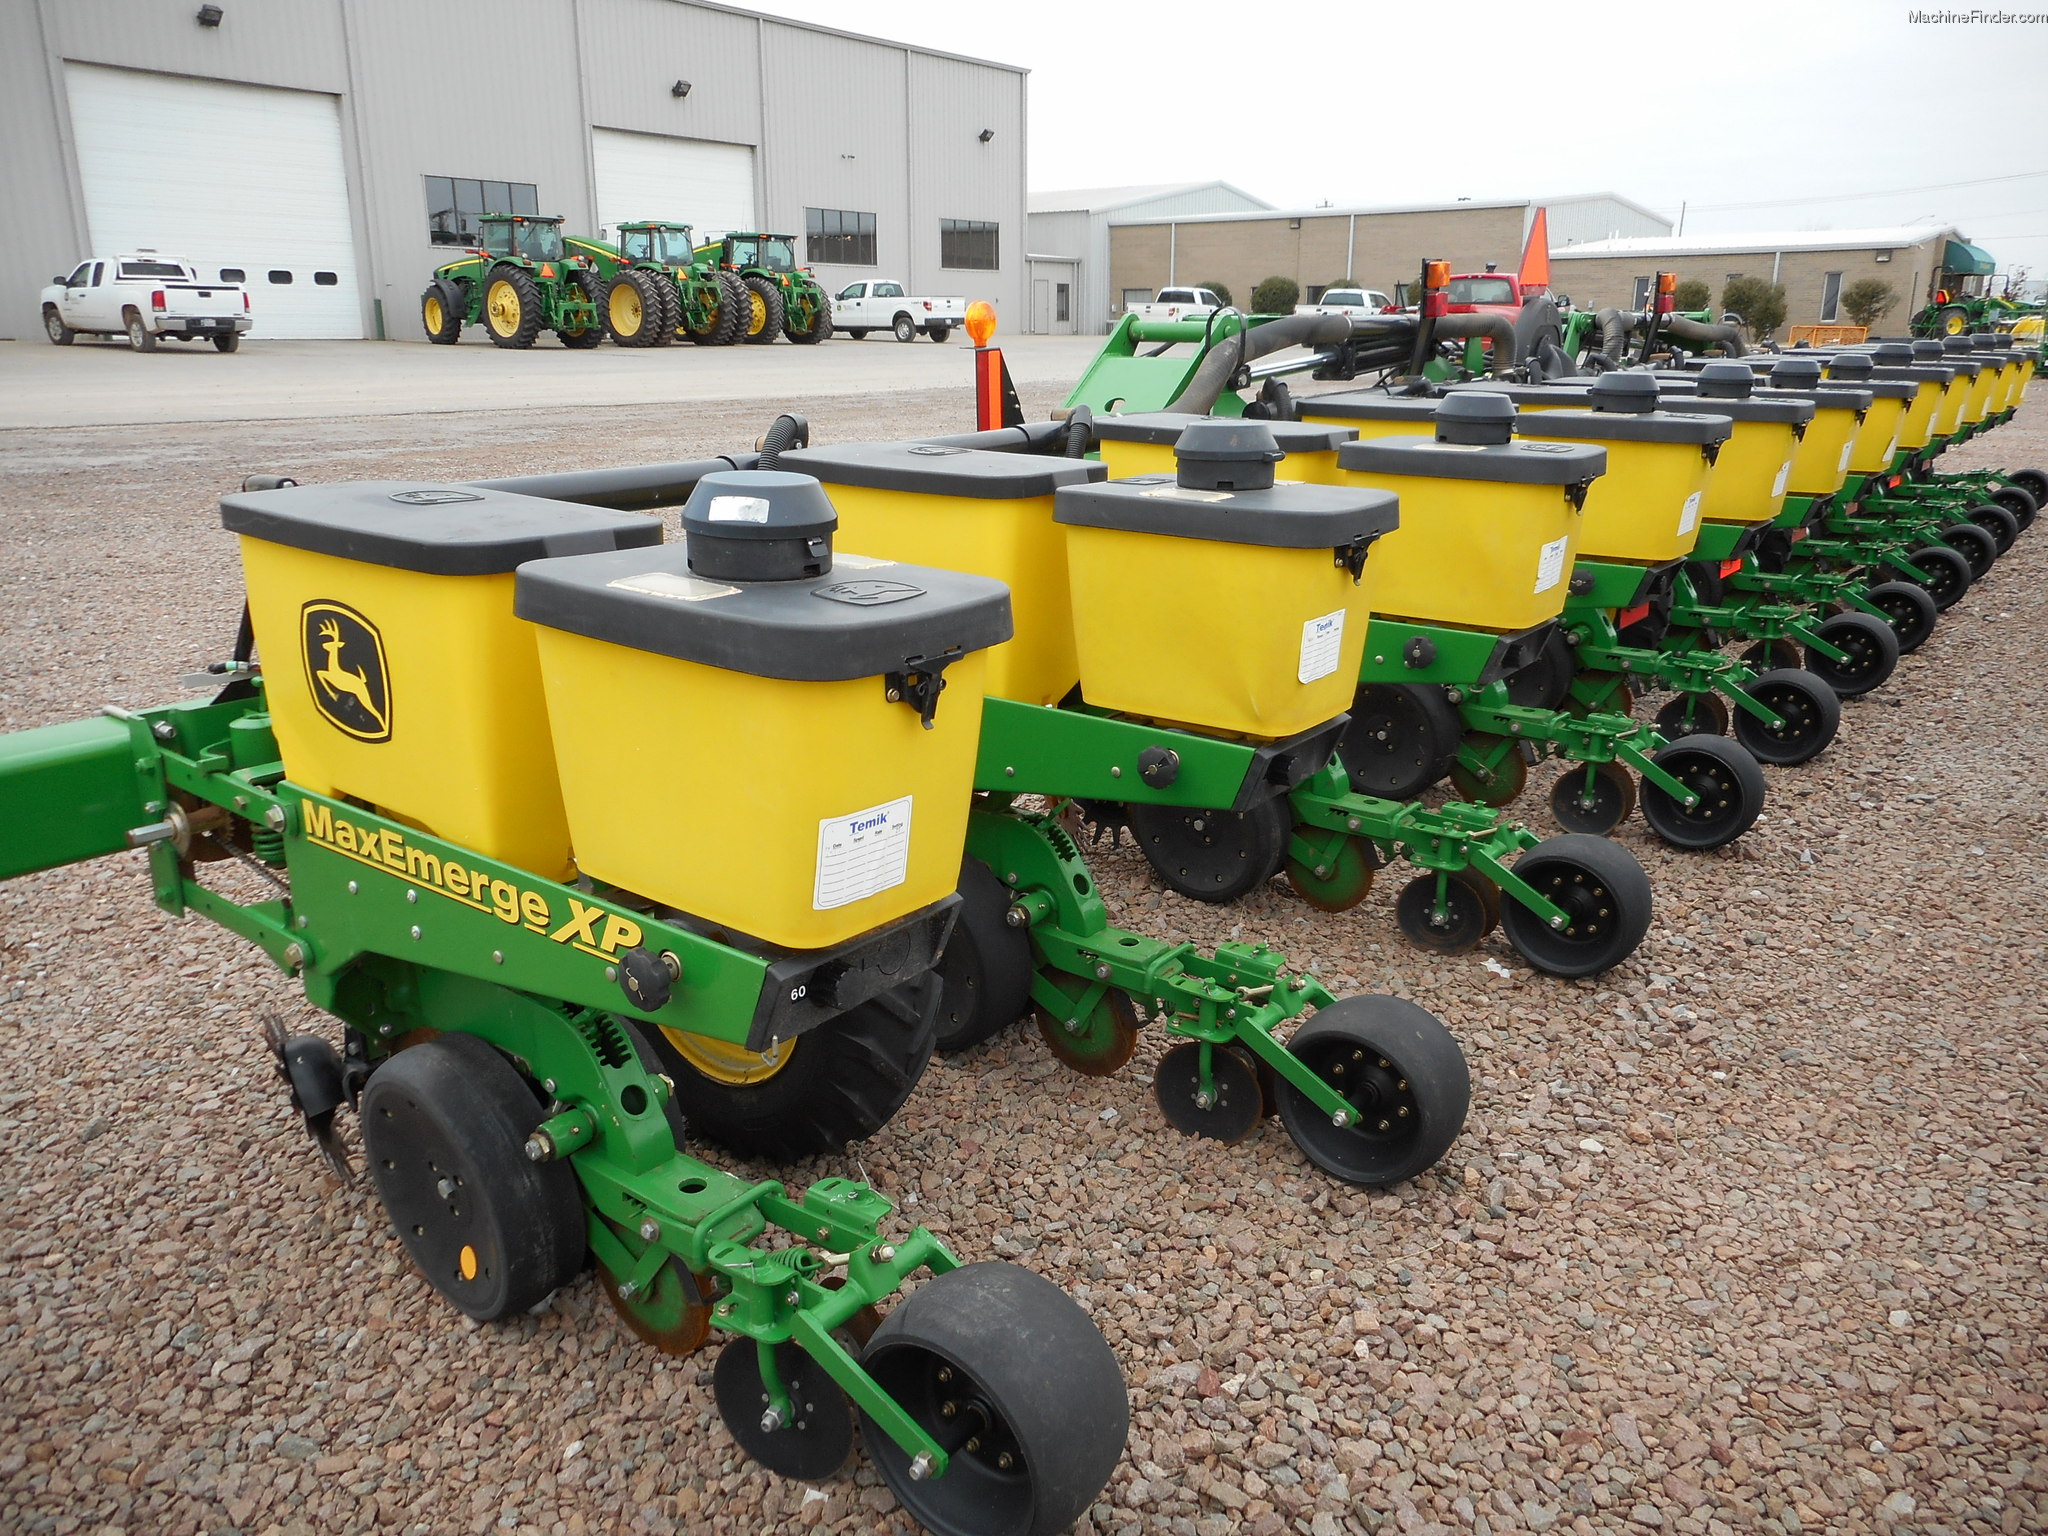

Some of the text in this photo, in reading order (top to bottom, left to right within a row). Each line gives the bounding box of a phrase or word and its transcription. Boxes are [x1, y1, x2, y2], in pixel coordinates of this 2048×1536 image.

[850, 812, 887, 834] Temik
[301, 798, 644, 953] MaxEmerge XP
[790, 985, 806, 1001] 60
